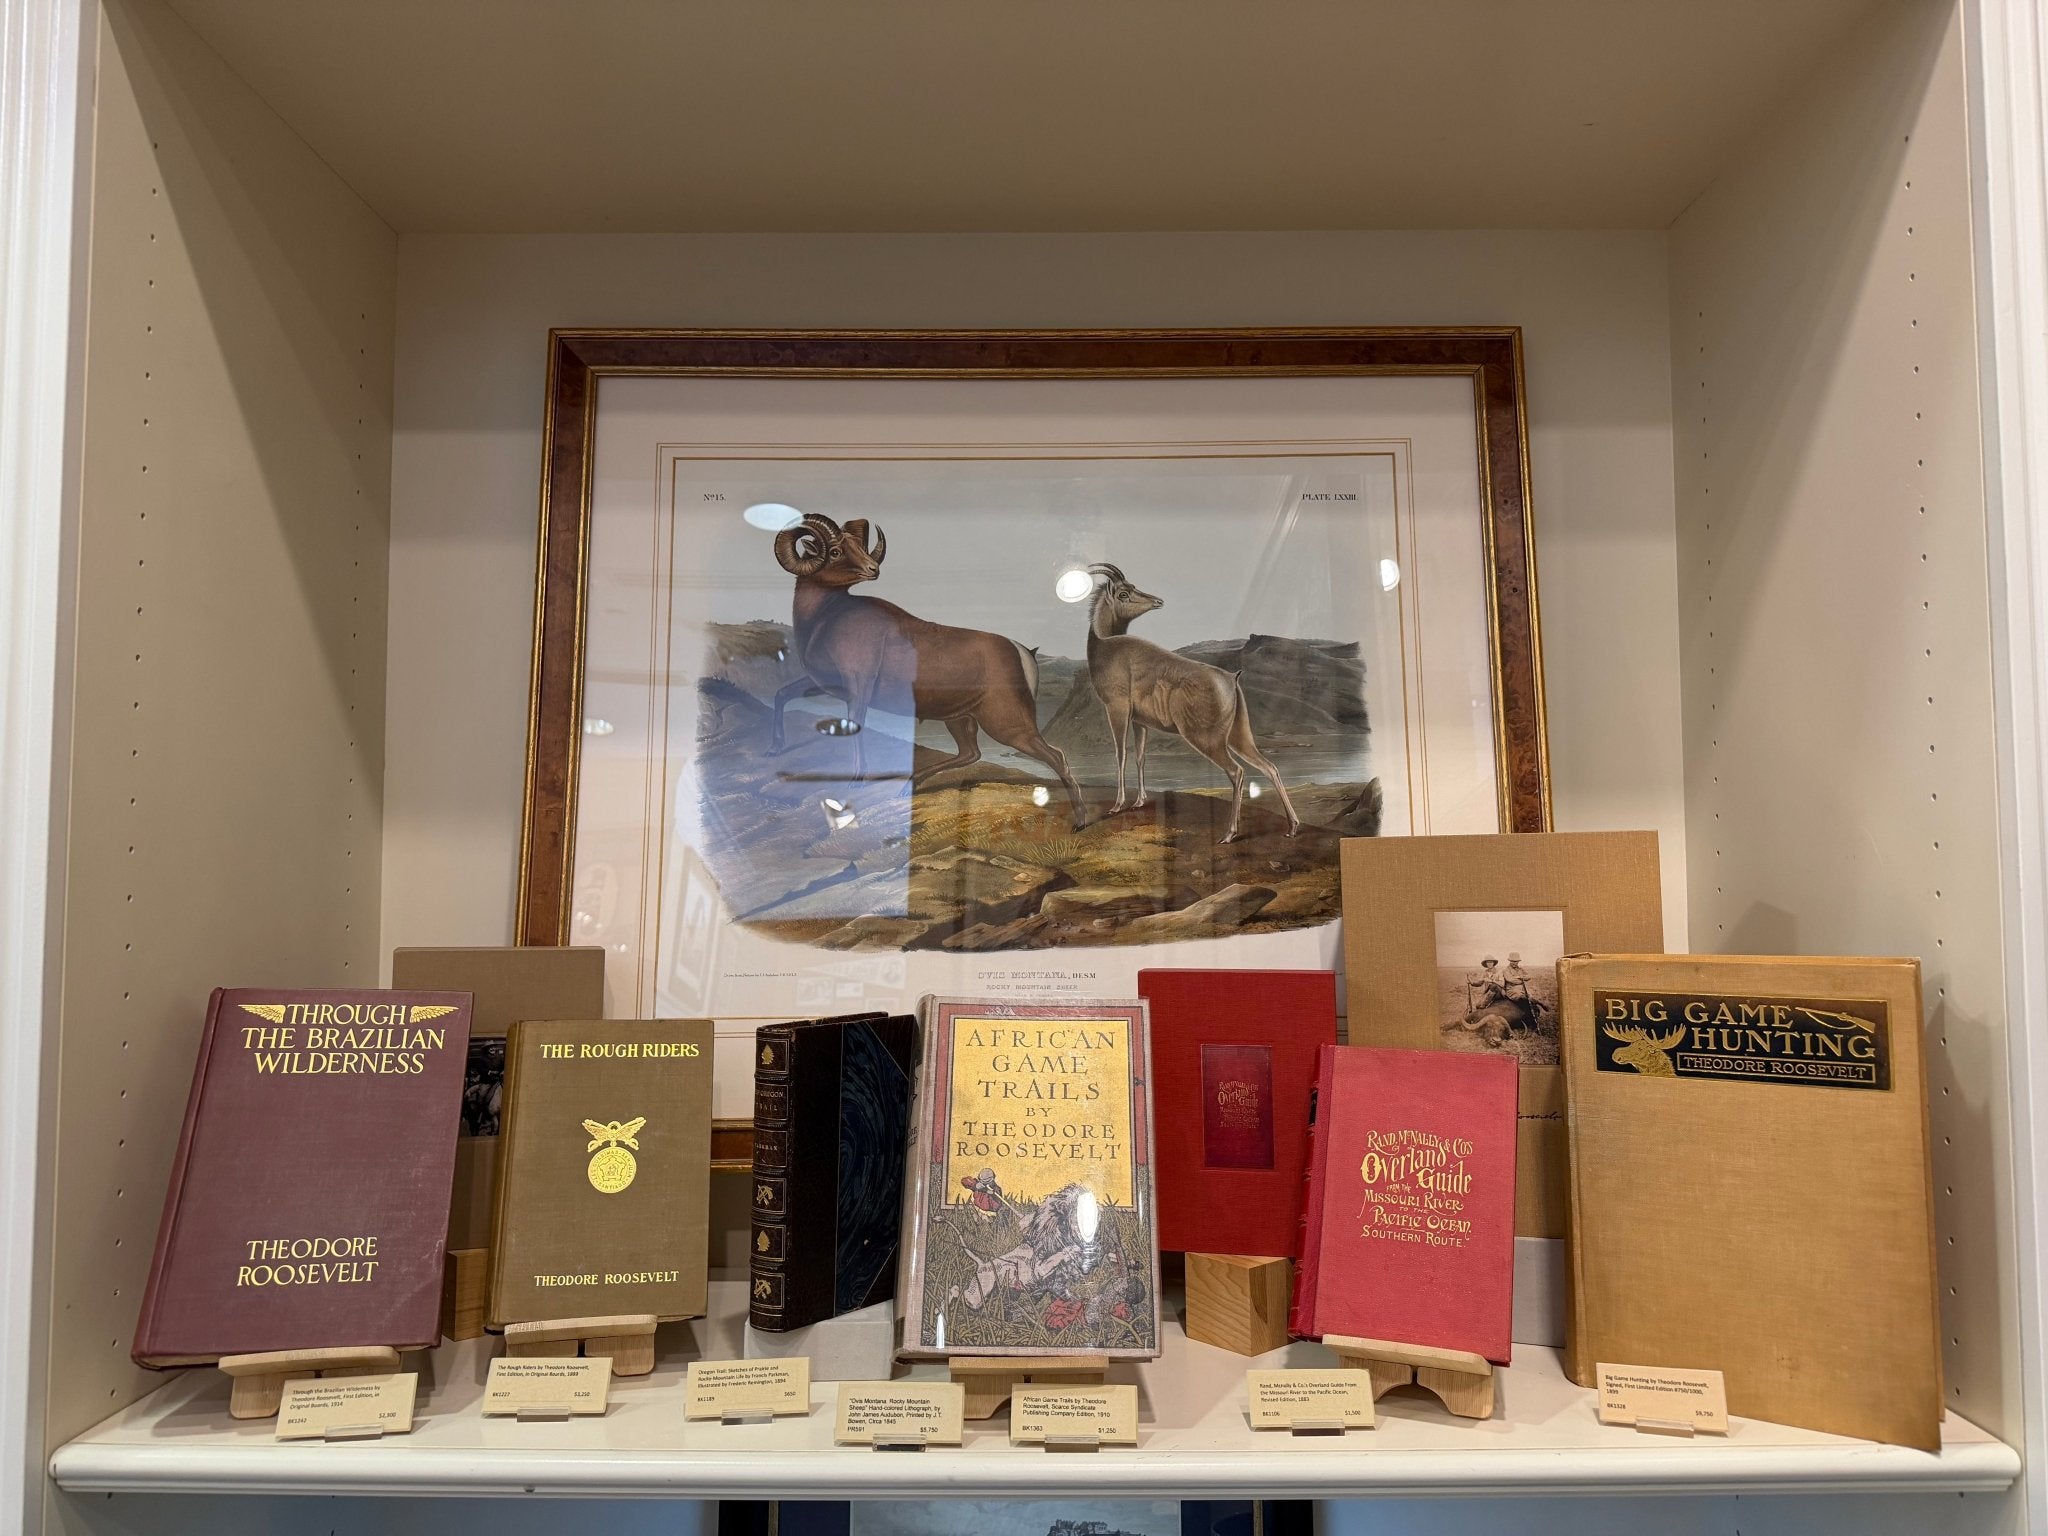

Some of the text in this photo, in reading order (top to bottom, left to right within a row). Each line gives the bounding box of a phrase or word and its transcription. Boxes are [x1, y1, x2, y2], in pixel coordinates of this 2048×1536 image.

[1302, 493, 1331, 501] PLATE
[286, 1004, 407, 1025] THROUGH
[1605, 998, 1794, 1028] BIG GAME
[240, 1027, 446, 1050] THE BRAZILIAN
[966, 1028, 1116, 1050] AFRICAN
[1691, 1026, 1876, 1059] HUNTING
[540, 1043, 700, 1059] THE ROUGH RIDERS
[254, 1052, 425, 1074] WILDERNESS
[992, 1053, 1089, 1074] GAME
[1683, 1055, 1868, 1080] THEODORE ROOSEVELT
[977, 1078, 1100, 1102] TRAILS
[1025, 1107, 1053, 1118] BY
[963, 1120, 1116, 1139] THEODORE
[956, 1141, 1122, 1161] ROOSEVELT
[1443, 1138, 1451, 1153] &
[1360, 1142, 1447, 1185] Overland
[1415, 1160, 1473, 1197] Guide
[1361, 1188, 1420, 1208] MISSOURI
[1369, 1205, 1422, 1228] PACIFIC
[1360, 1224, 1466, 1248] SOUTHERN ROUTE.
[246, 1236, 378, 1261] THEODORE
[236, 1261, 379, 1287] ROOSEVELT
[534, 1270, 680, 1287] THEODORE ROOSEVELT
[1605, 1381, 1624, 1389] Signed,
[1629, 1376, 1650, 1384] Hunting
[1657, 1378, 1682, 1386] Theodore
[1682, 1380, 1709, 1388] Roosevelt,
[1050, 1410, 1075, 1418] Company
